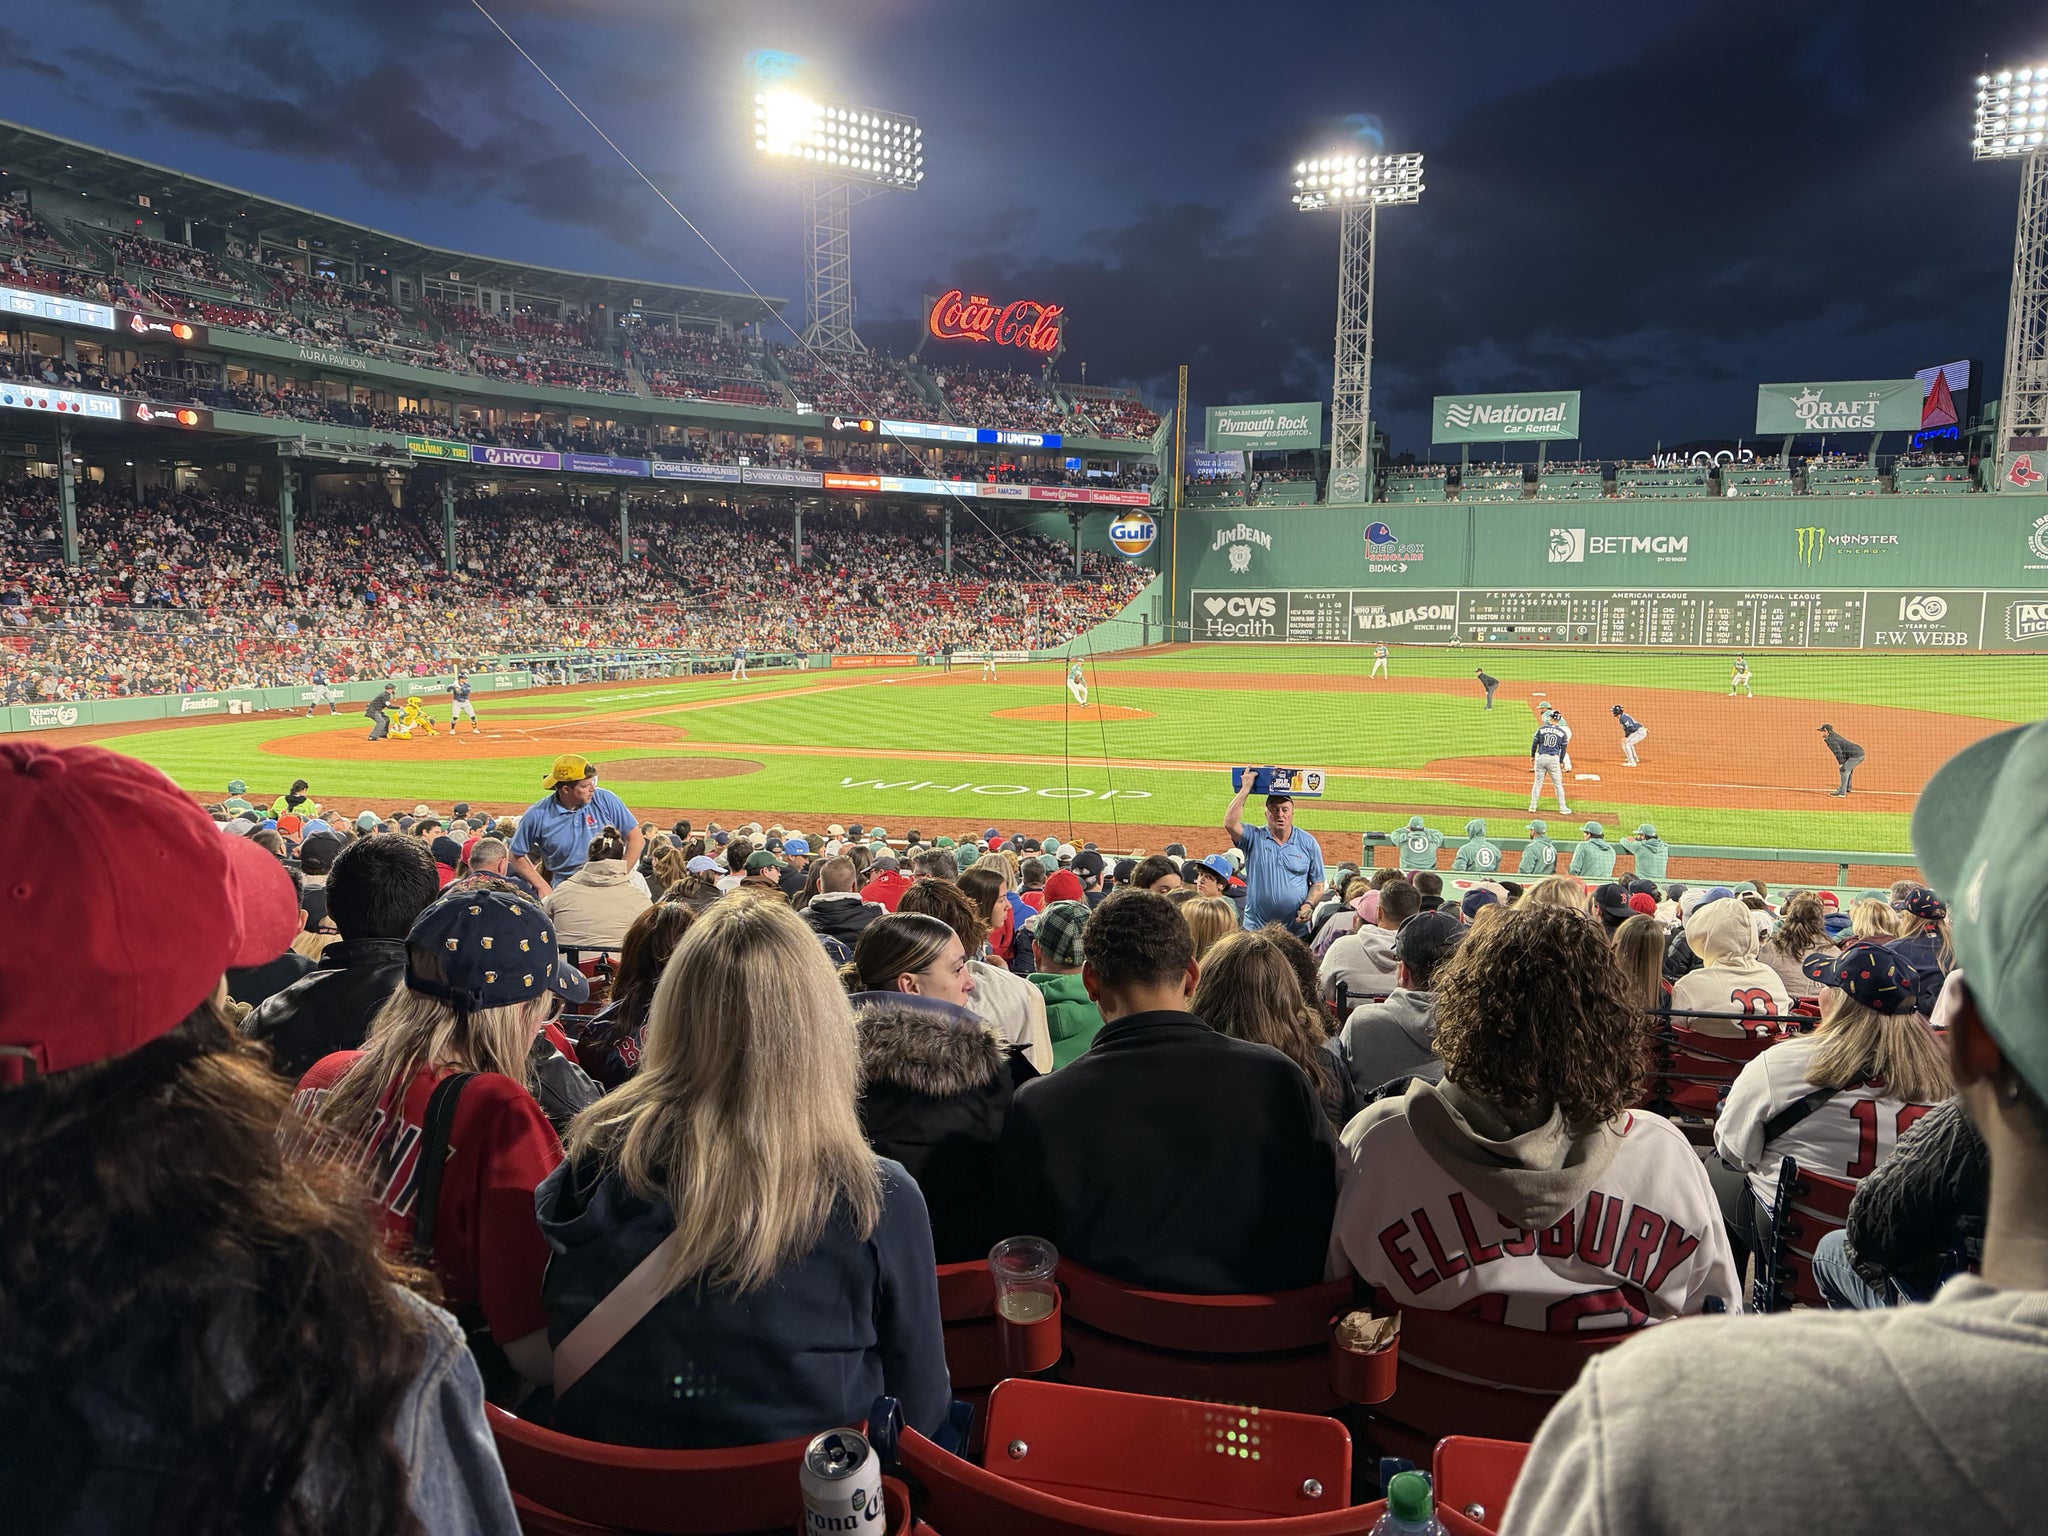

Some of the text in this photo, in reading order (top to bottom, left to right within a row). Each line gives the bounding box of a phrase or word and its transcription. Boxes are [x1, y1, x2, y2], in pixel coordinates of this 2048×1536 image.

[970, 296, 989, 305] ENJOY
[929, 289, 1064, 352] Coca-Cola
[329, 355, 366, 369] PAVILION
[20, 387, 113, 414] STRIKE OUT 5TH
[1795, 400, 1880, 419] DRAFT
[1217, 415, 1309, 432] Plymouth Rock
[1503, 423, 1561, 433] Car Rental
[1805, 415, 1876, 429] KINGS
[408, 442, 467, 458] SULLIVAN TIRE
[503, 453, 541, 465] HYCU
[1194, 459, 1211, 467] Your
[654, 463, 692, 473] COGHLIN
[691, 466, 739, 476] COMPANIES
[753, 471, 820, 483] VINEYARD VINES
[998, 487, 1022, 495] AMAZING
[1093, 493, 1121, 501] Safelite
[1111, 525, 1154, 540] Gulf
[1590, 536, 1689, 553] BETMGM
[1828, 534, 1899, 545] MONSTER
[1370, 544, 1425, 554] RED SOX
[1369, 553, 1424, 561] SCHOLARS
[1369, 564, 1398, 573] BIDMC
[1227, 597, 1276, 617] CVS
[1205, 618, 1275, 637] Health
[1478, 632, 1484, 641] 6
[1875, 631, 1968, 646] F.W. WEBB
[424, 684, 446, 693] TICKET
[181, 698, 220, 712] Franklin
[29, 708, 58, 716] Ninety
[30, 715, 58, 726] Nine
[1543, 733, 1558, 747] 10
[840, 777, 1153, 800] WHOOP
